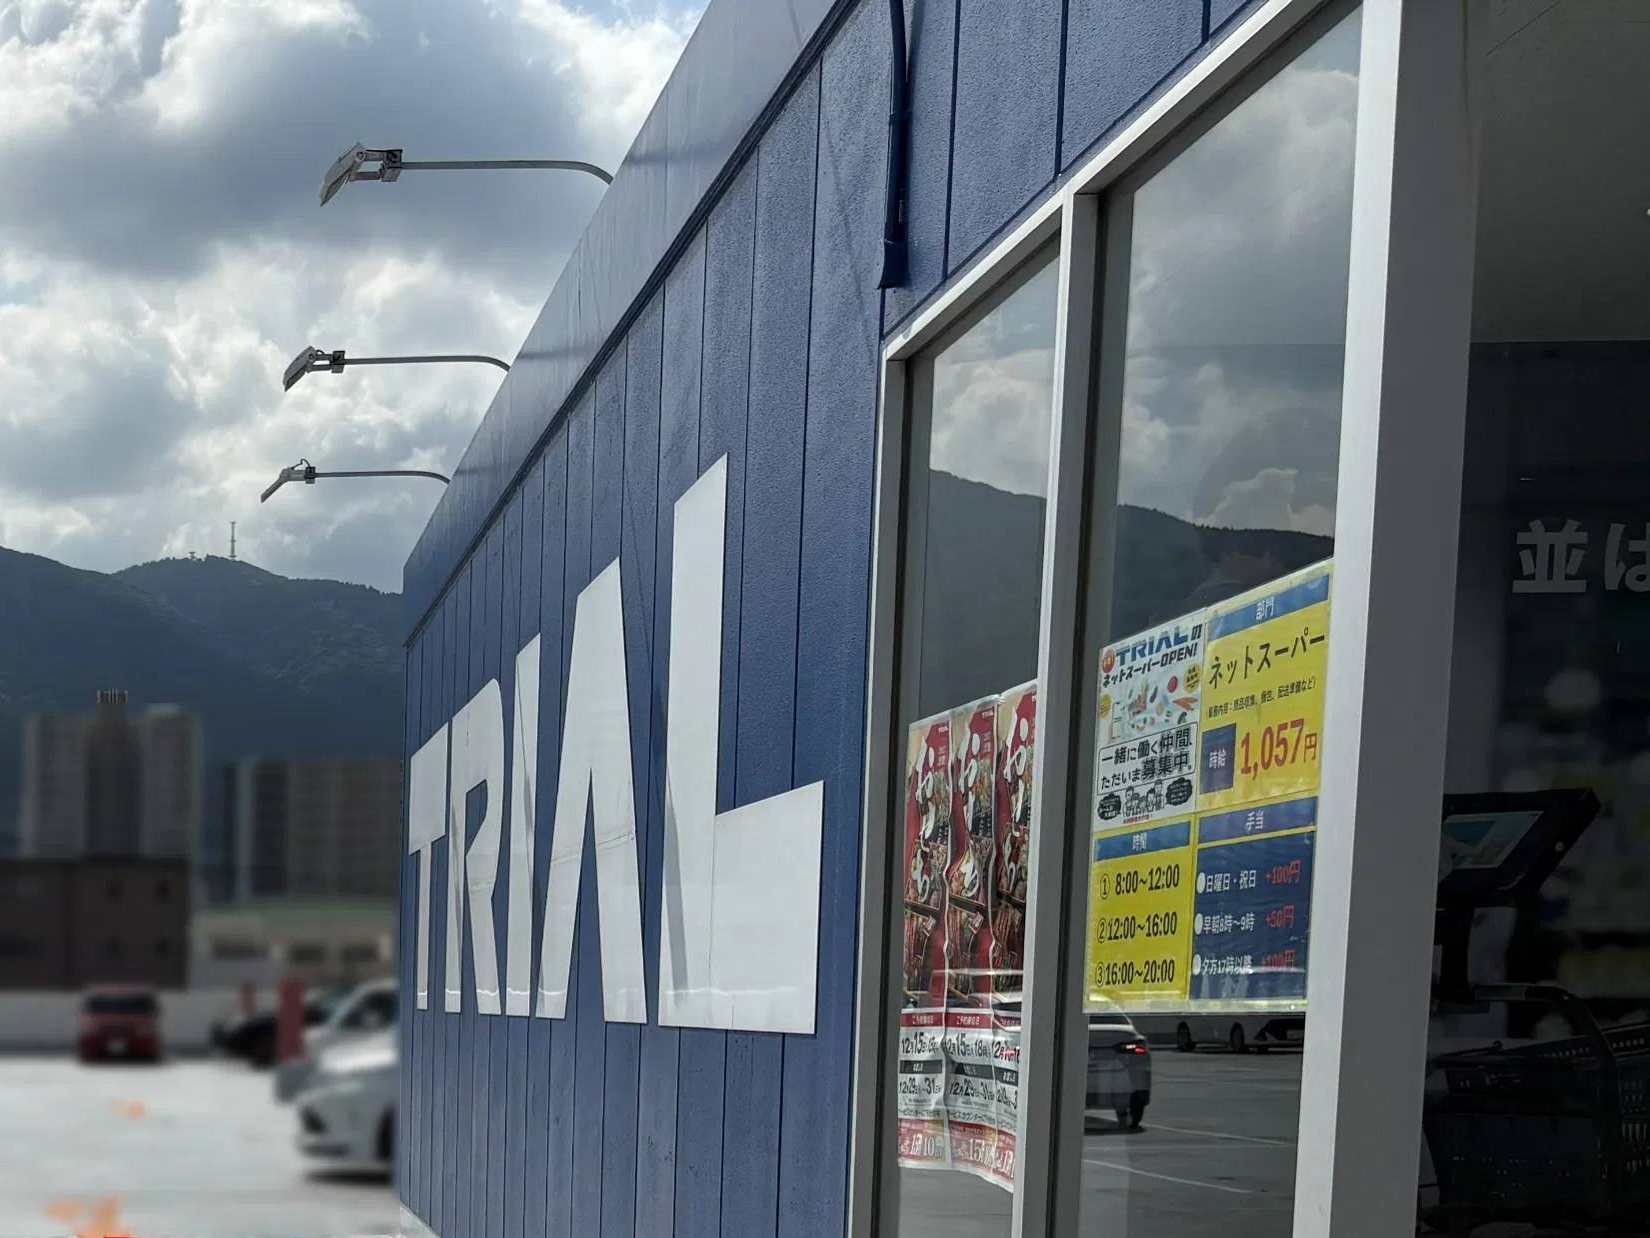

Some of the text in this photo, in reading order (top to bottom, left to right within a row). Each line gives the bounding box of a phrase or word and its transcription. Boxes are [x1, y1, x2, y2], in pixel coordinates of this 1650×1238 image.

[1208, 626, 1326, 690] ネットスーパー
[408, 452, 825, 1035] TRIAL
[1208, 747, 1227, 770] 時給
